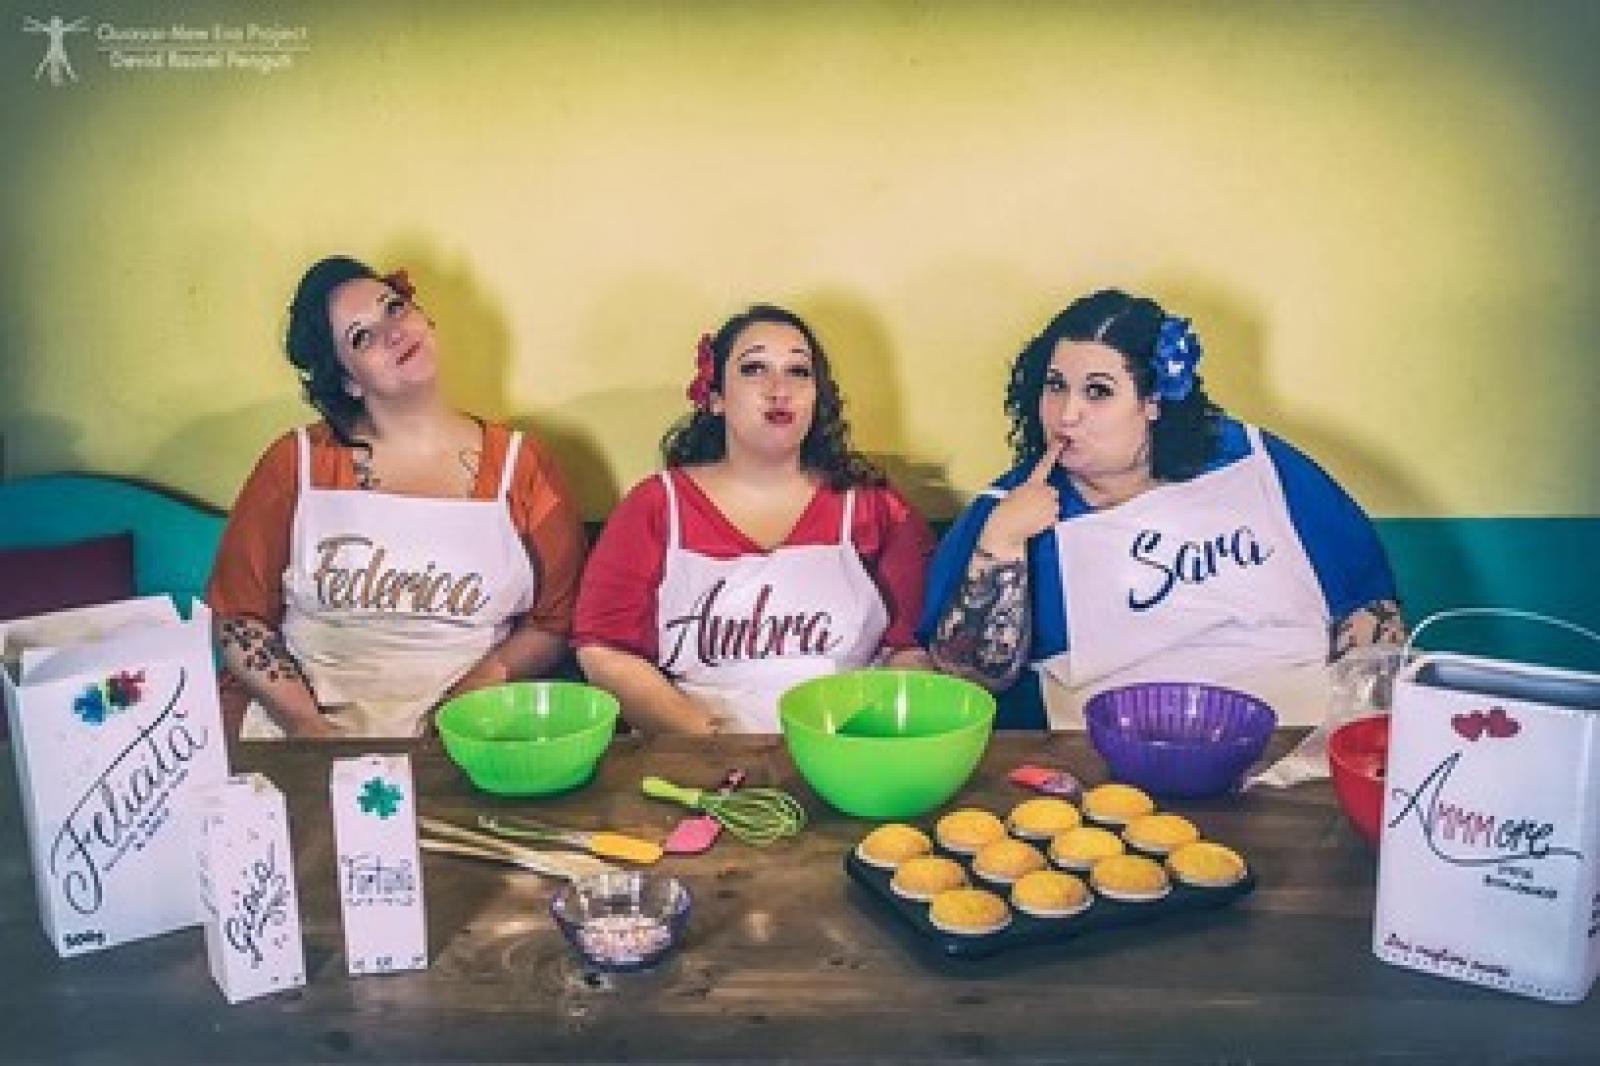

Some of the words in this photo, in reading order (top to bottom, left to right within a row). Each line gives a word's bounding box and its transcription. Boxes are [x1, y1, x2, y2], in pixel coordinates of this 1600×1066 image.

[312, 533, 491, 618] Federica
[1129, 526, 1275, 612] Sara
[660, 577, 842, 680] Ambra
